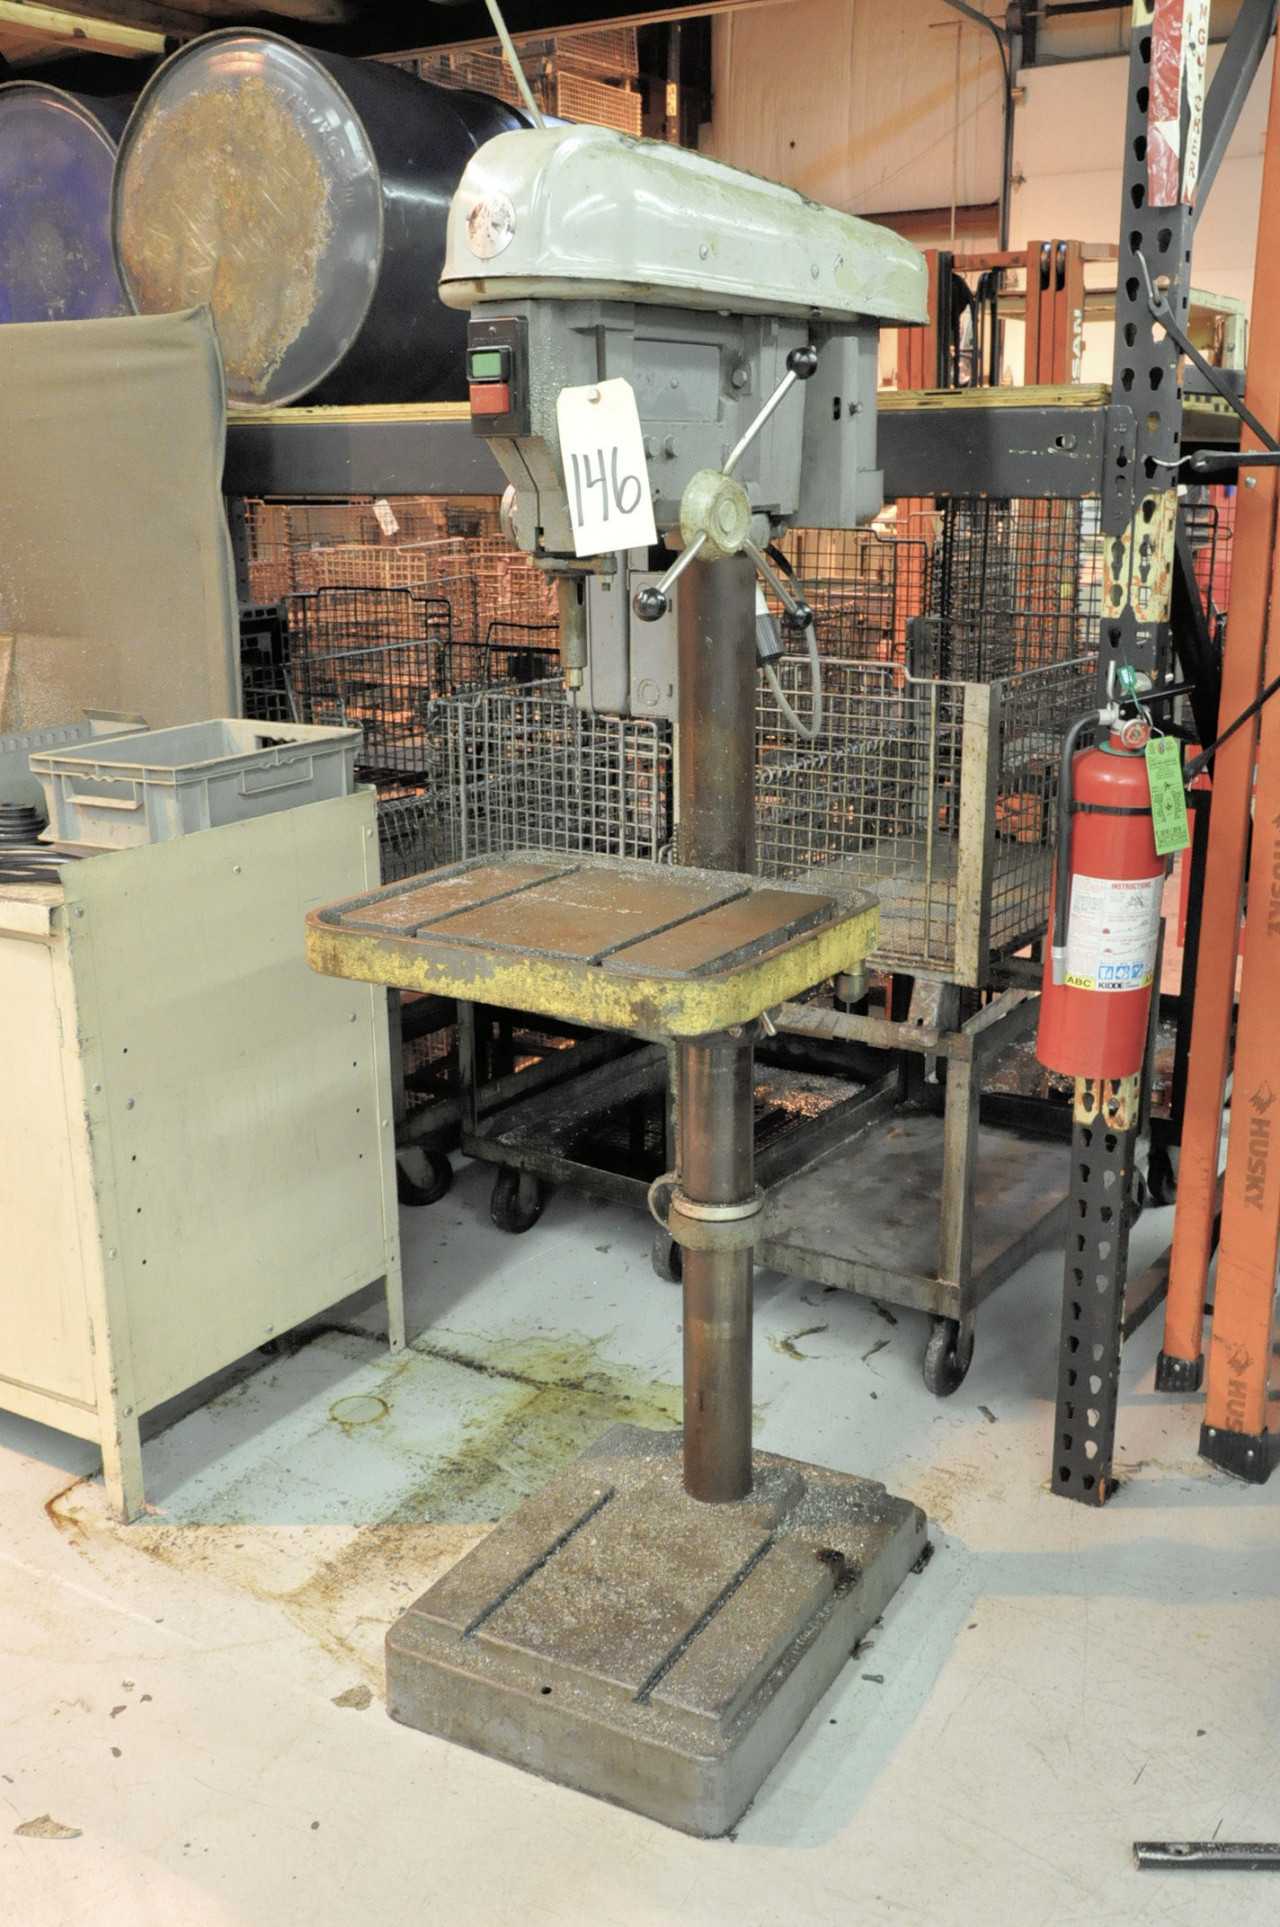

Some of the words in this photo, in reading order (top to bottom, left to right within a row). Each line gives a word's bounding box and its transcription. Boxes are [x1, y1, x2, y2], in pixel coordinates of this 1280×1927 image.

[571, 446, 641, 528] 146
[1066, 975, 1091, 988] ABC
[1243, 1117, 1271, 1212] HUSKY
